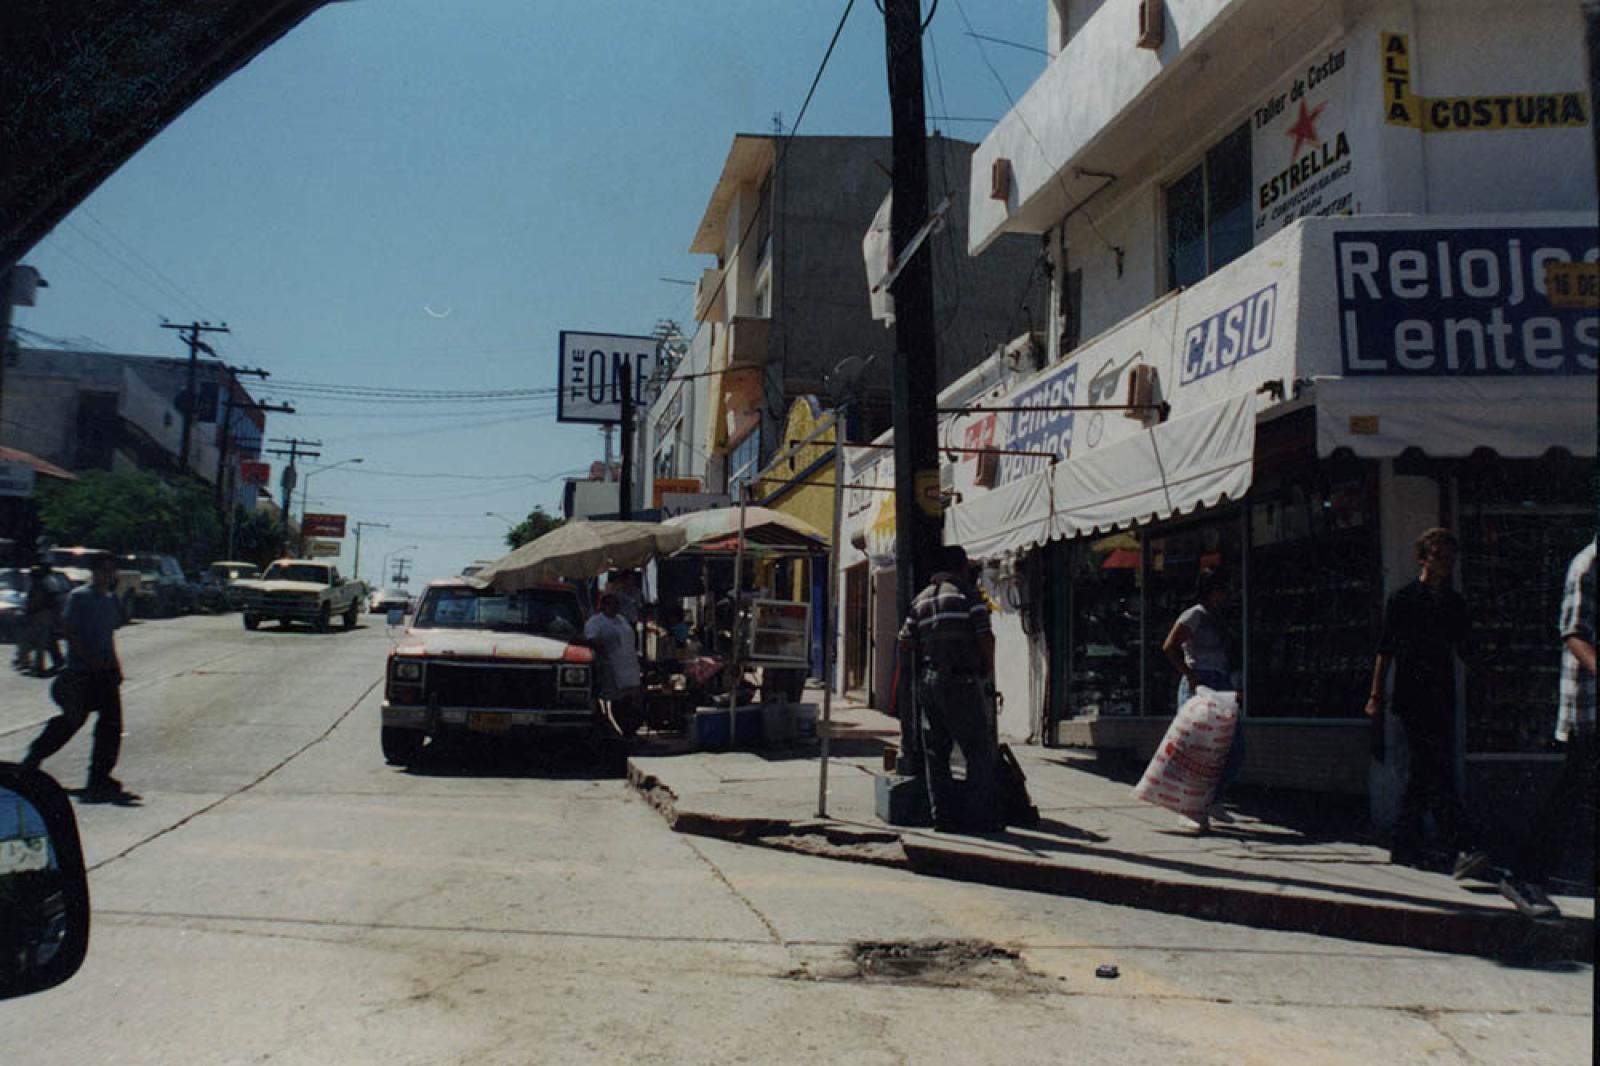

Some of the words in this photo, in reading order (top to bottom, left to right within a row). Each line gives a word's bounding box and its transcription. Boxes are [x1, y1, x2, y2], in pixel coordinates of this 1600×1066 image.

[1254, 93, 1287, 129] Taller
[1291, 79, 1305, 102] de
[1385, 35, 1410, 121] ALTA
[1431, 93, 1586, 128] COSTURA
[1259, 131, 1351, 210] ESTRELLA
[1185, 284, 1276, 384] CASIO
[1344, 307, 1598, 371] Lentes
[572, 349, 585, 402] THE
[588, 349, 649, 406] ONE
[1004, 371, 1076, 442] Lentes
